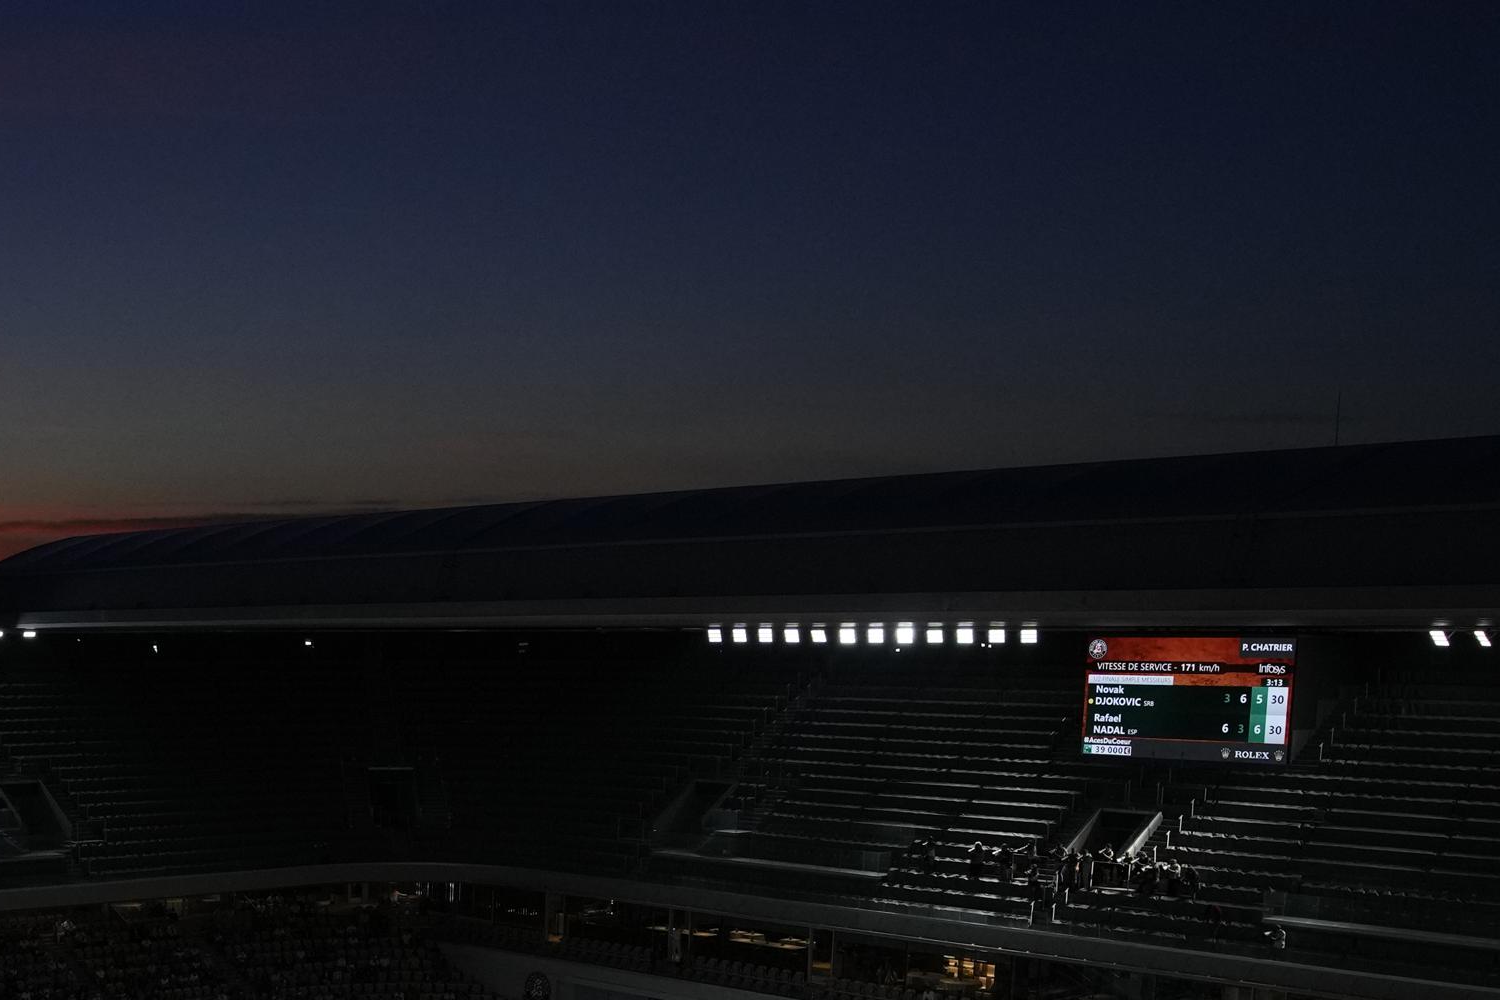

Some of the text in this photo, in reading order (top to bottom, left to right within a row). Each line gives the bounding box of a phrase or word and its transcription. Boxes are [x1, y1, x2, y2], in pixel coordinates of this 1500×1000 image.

[1242, 643, 1293, 652] P. CHATRIER
[1097, 662, 1126, 671] VITESSE
[1128, 662, 1138, 671] DE
[1140, 663, 1172, 672] SERVICE
[1181, 664, 1196, 672] 171
[1199, 663, 1220, 673] km/h
[1258, 663, 1286, 675] Infosys
[1266, 679, 1283, 687] 3:13
[1096, 684, 1124, 695] Novak
[1095, 696, 1141, 707] DJOKOVIC
[1224, 693, 1284, 705] 3 6 5 30
[1094, 713, 1122, 723] Rafael
[1093, 725, 1125, 735] NADAL
[1221, 723, 1282, 735] 6 3 6 30
[1083, 736, 1132, 745] #AcesDuCoeur
[1235, 750, 1269, 760] ROLEX
